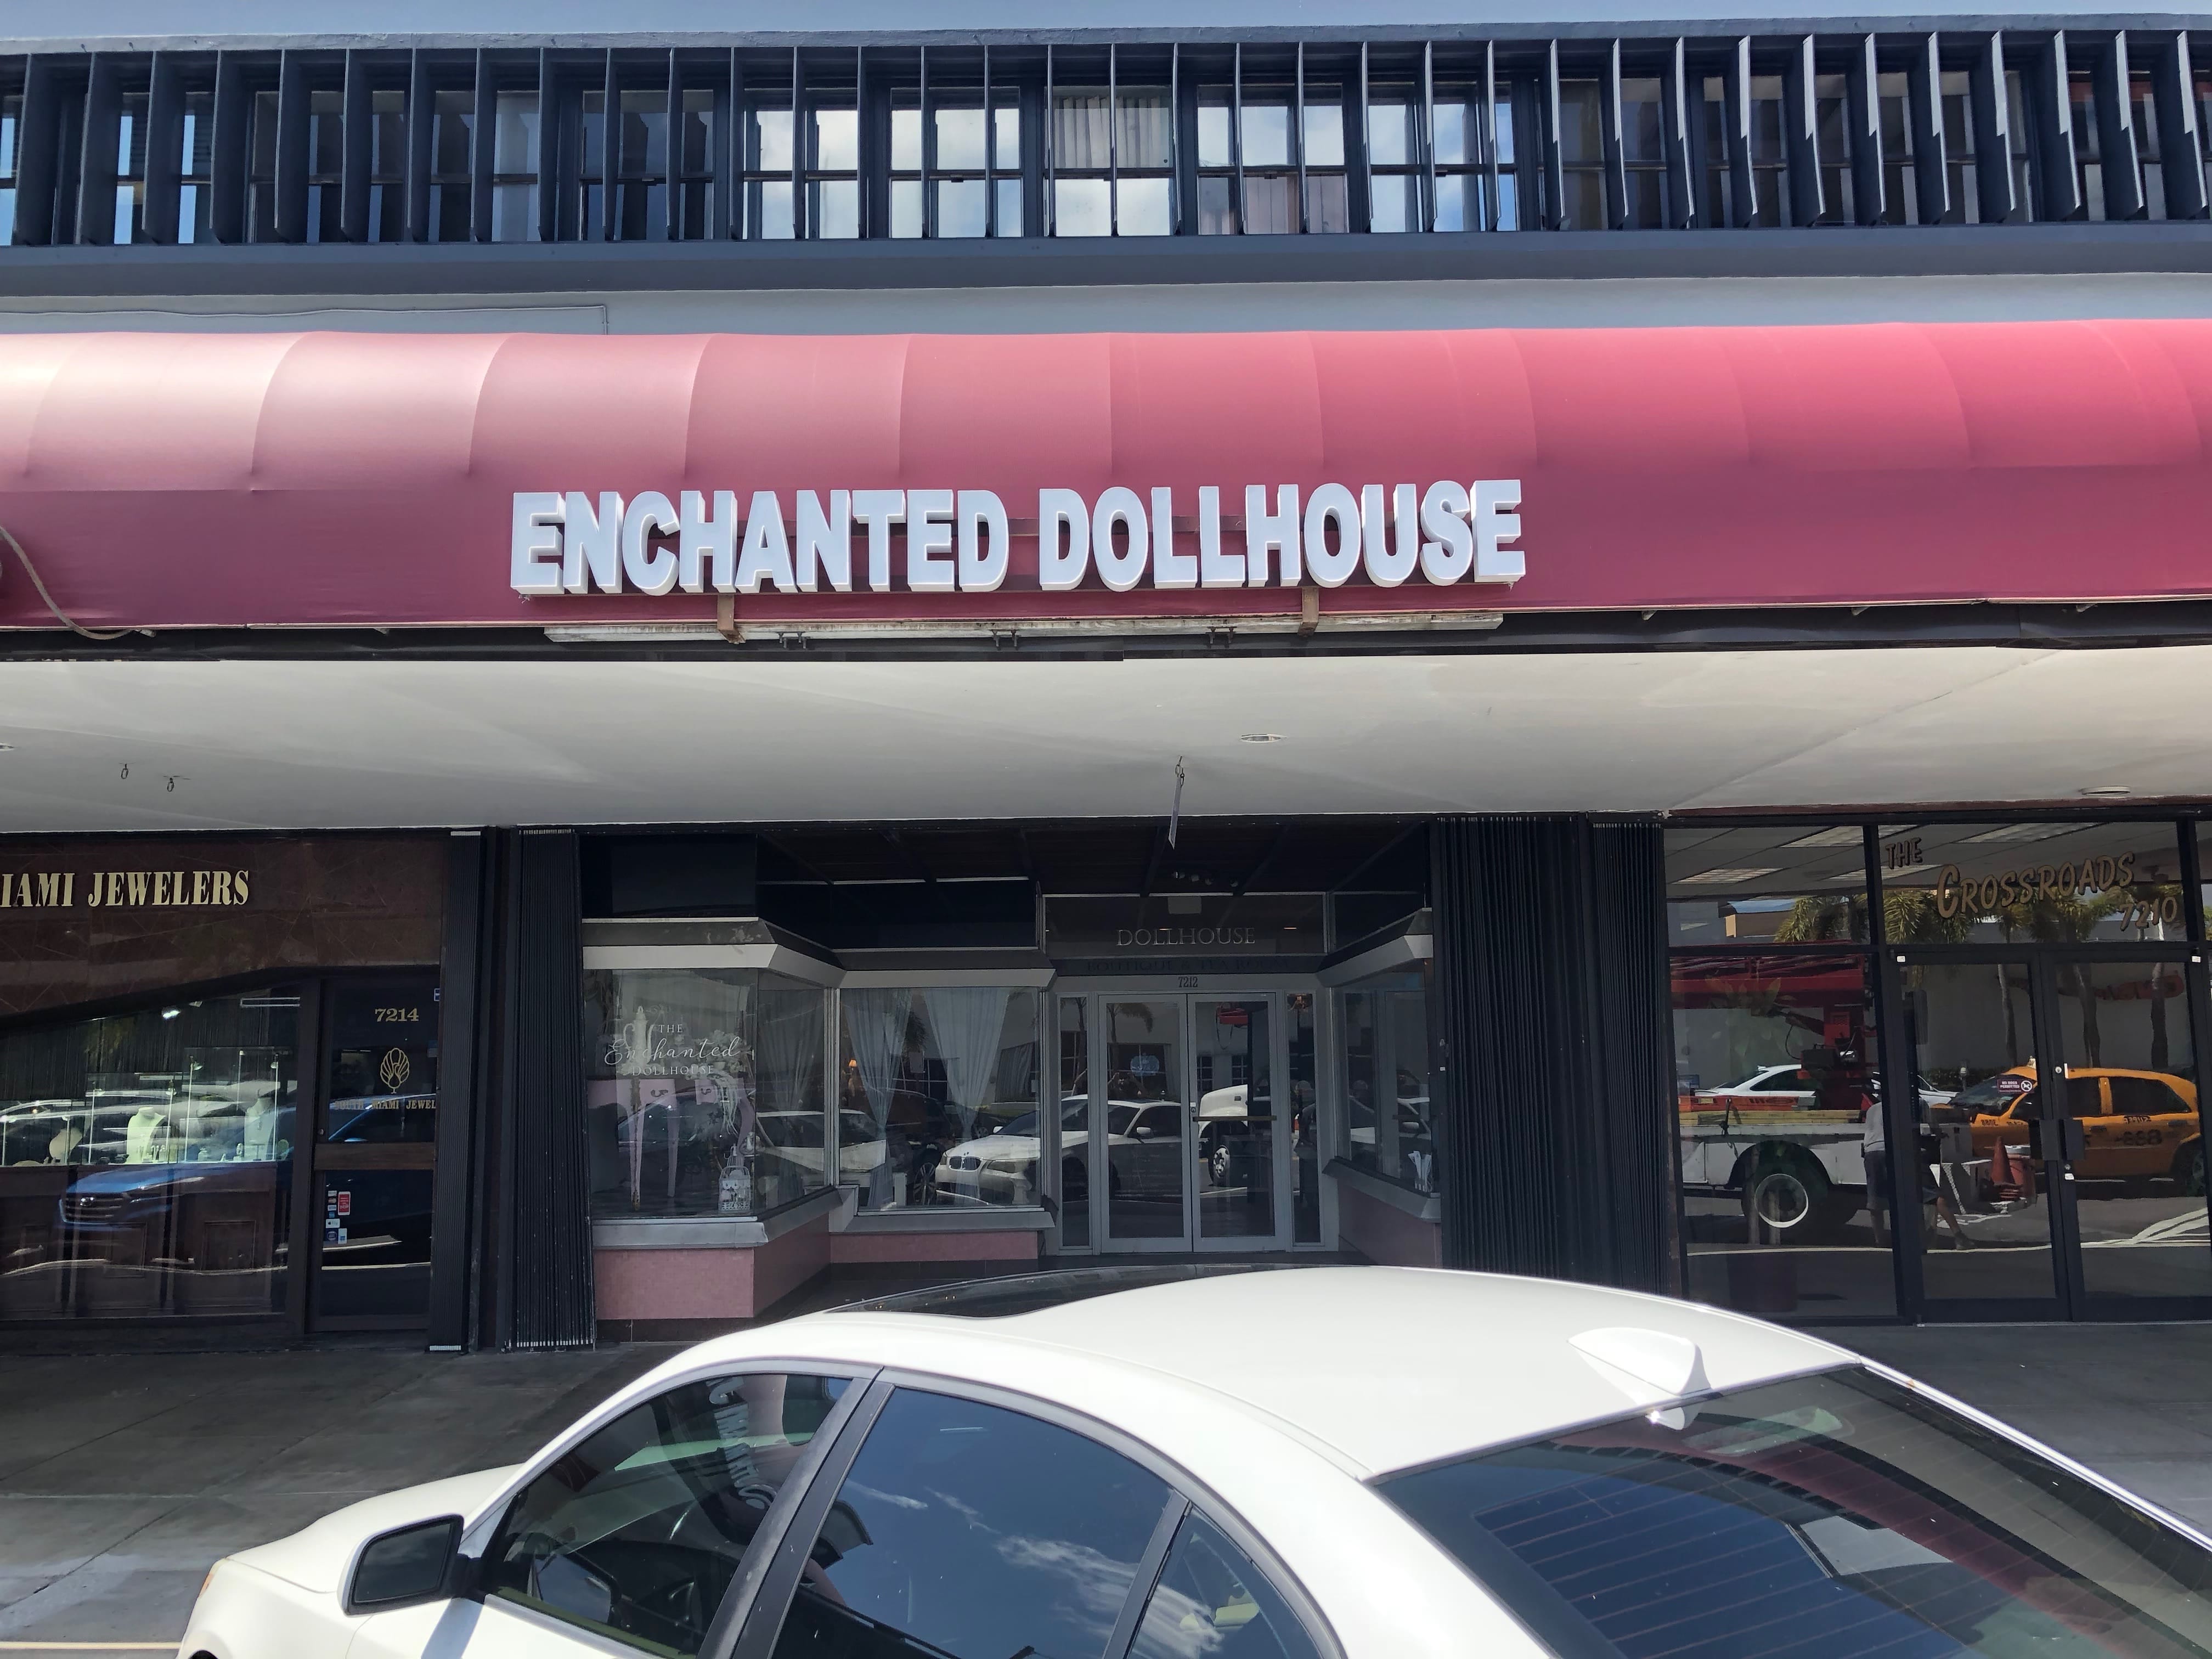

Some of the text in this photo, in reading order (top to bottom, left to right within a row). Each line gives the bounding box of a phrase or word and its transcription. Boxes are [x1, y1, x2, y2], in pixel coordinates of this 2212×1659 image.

[510, 479, 1526, 596] ENCHANTED DOLLHOUSE
[1886, 837, 1923, 870] THE
[88, 870, 250, 907] JEWELERS
[1937, 851, 2136, 919] CROSSROADS
[2119, 895, 2179, 932] 7210
[1116, 927, 1256, 946] DOLLHOUSE
[1178, 976, 1198, 988] 7212
[375, 1008, 420, 1022] 7214
[658, 1024, 683, 1033] THE
[604, 1036, 742, 1065] Enchanted
[632, 1065, 714, 1076] DOLLHOUSE
[372, 1100, 399, 1109] MIAMI
[406, 1099, 436, 1109] JEWEL
